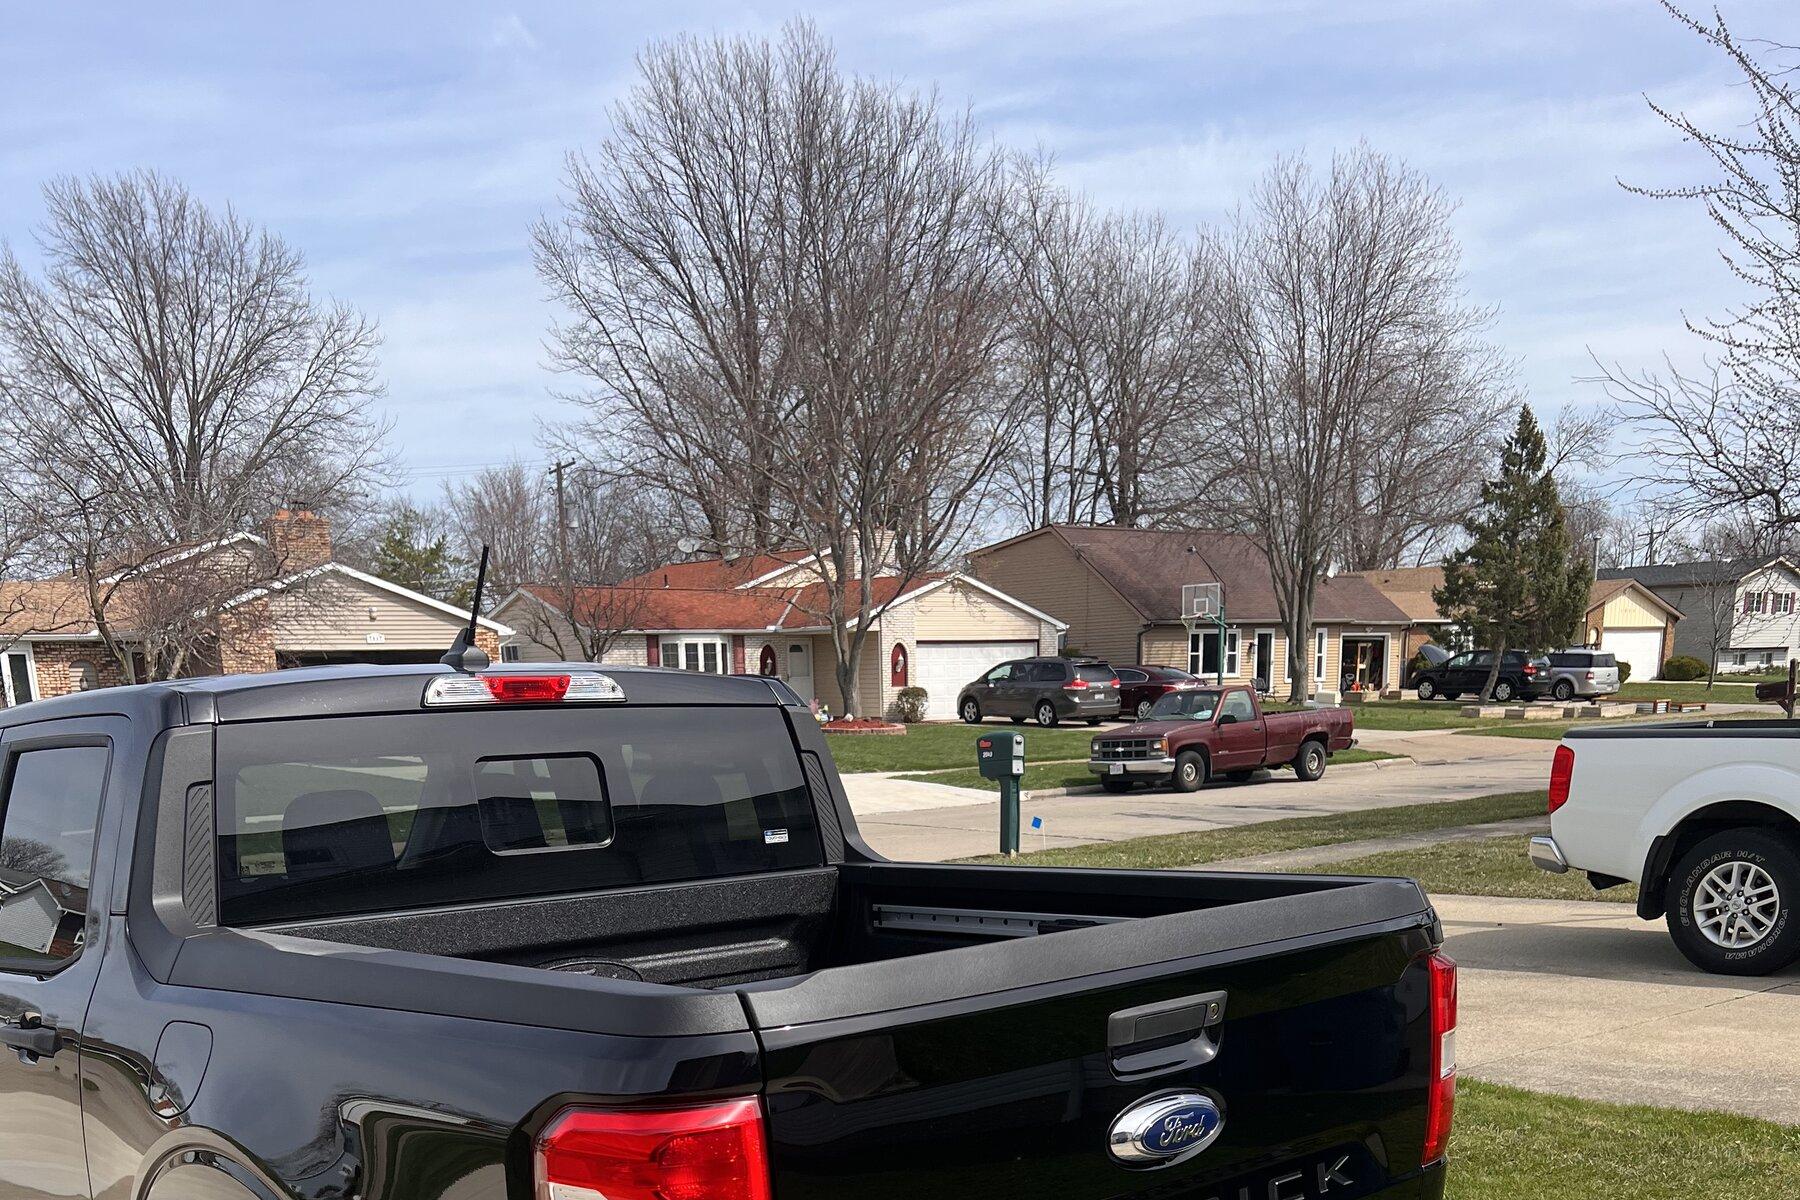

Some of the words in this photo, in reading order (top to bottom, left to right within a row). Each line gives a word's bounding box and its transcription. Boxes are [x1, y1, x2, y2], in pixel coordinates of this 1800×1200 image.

[1679, 850, 1732, 927] GEOLANDAR
[1725, 908, 1789, 960] YOKOHAMA
[1160, 1111, 1206, 1147] Ford
